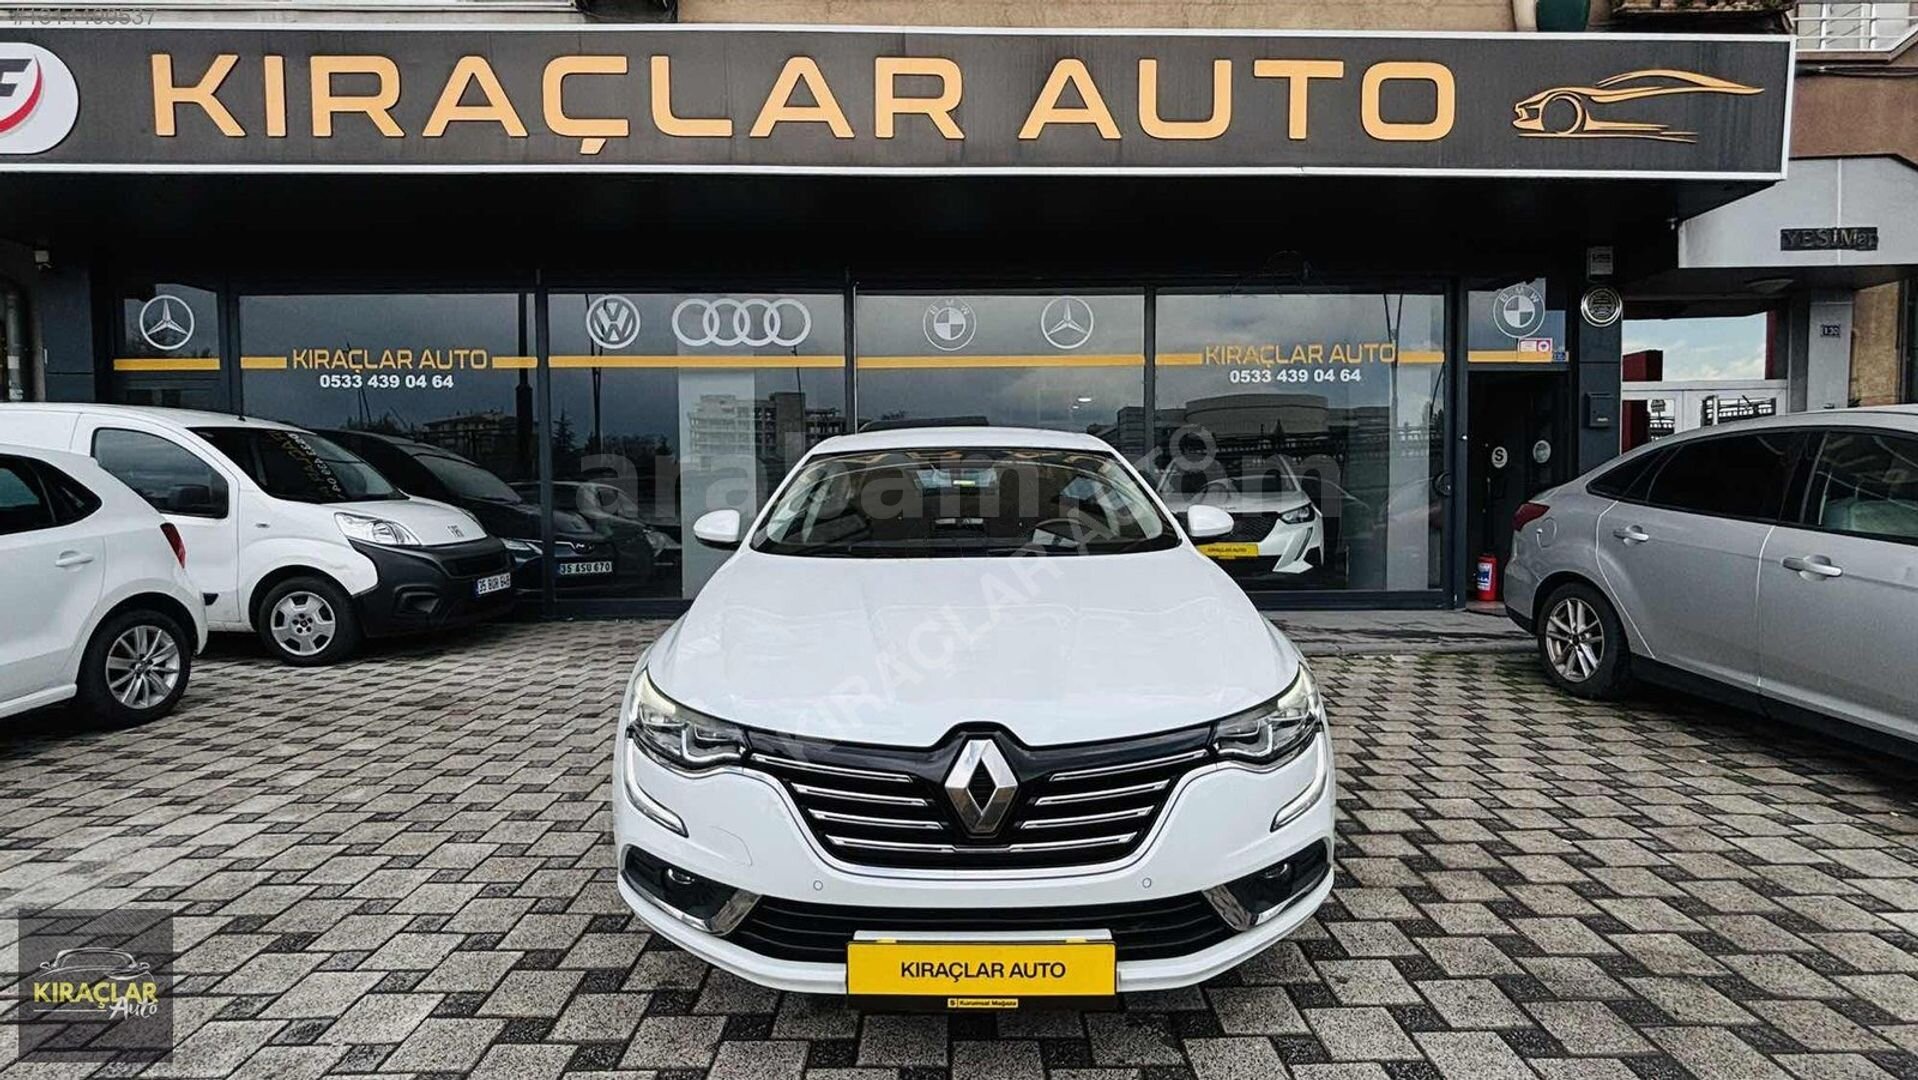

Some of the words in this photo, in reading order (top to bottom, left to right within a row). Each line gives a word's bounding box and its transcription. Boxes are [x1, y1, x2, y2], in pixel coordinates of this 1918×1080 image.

[151, 53, 964, 154] KIRAÇLAR
[1018, 58, 1455, 141] AUTO
[293, 349, 412, 373] KIRAÇLAR
[419, 348, 487, 369] AUTO
[1206, 345, 1323, 368] KIRAÇLAR
[1329, 343, 1396, 363] AUTO
[320, 374, 362, 388] 0533
[367, 374, 400, 388] 439
[405, 374, 427, 387] 04
[432, 374, 454, 387] 64
[1229, 369, 1271, 383] 0533
[1276, 369, 1308, 382] 439
[1314, 369, 1335, 382] 04
[1340, 368, 1361, 382] 64
[901, 962, 1004, 982] KIRAÇLAR
[1009, 962, 1066, 978] AUTO
